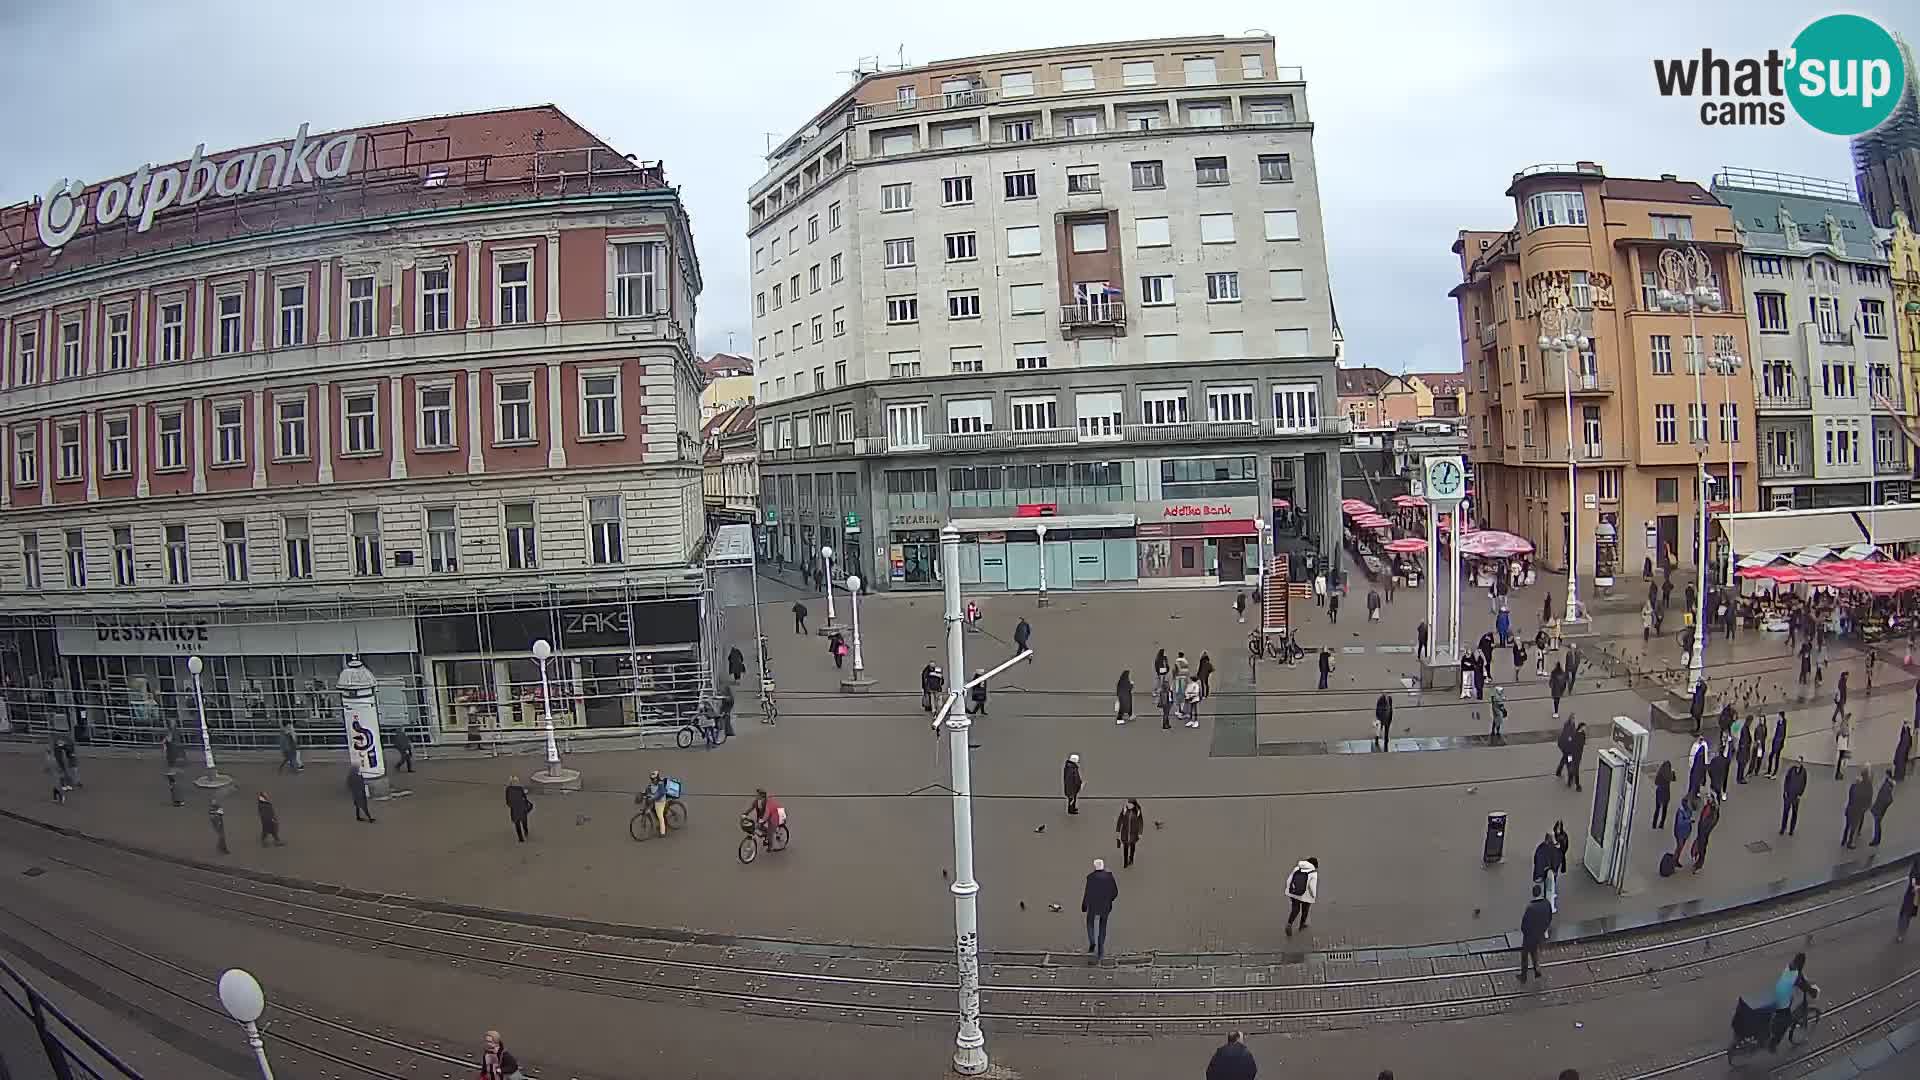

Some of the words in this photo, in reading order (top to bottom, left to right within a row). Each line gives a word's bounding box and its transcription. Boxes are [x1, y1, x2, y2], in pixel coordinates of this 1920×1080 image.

[1163, 505, 1201, 517] Addiko
[1203, 504, 1232, 516] Bank
[96, 620, 208, 641] DESSANGE
[564, 611, 630, 633] ZAKS
